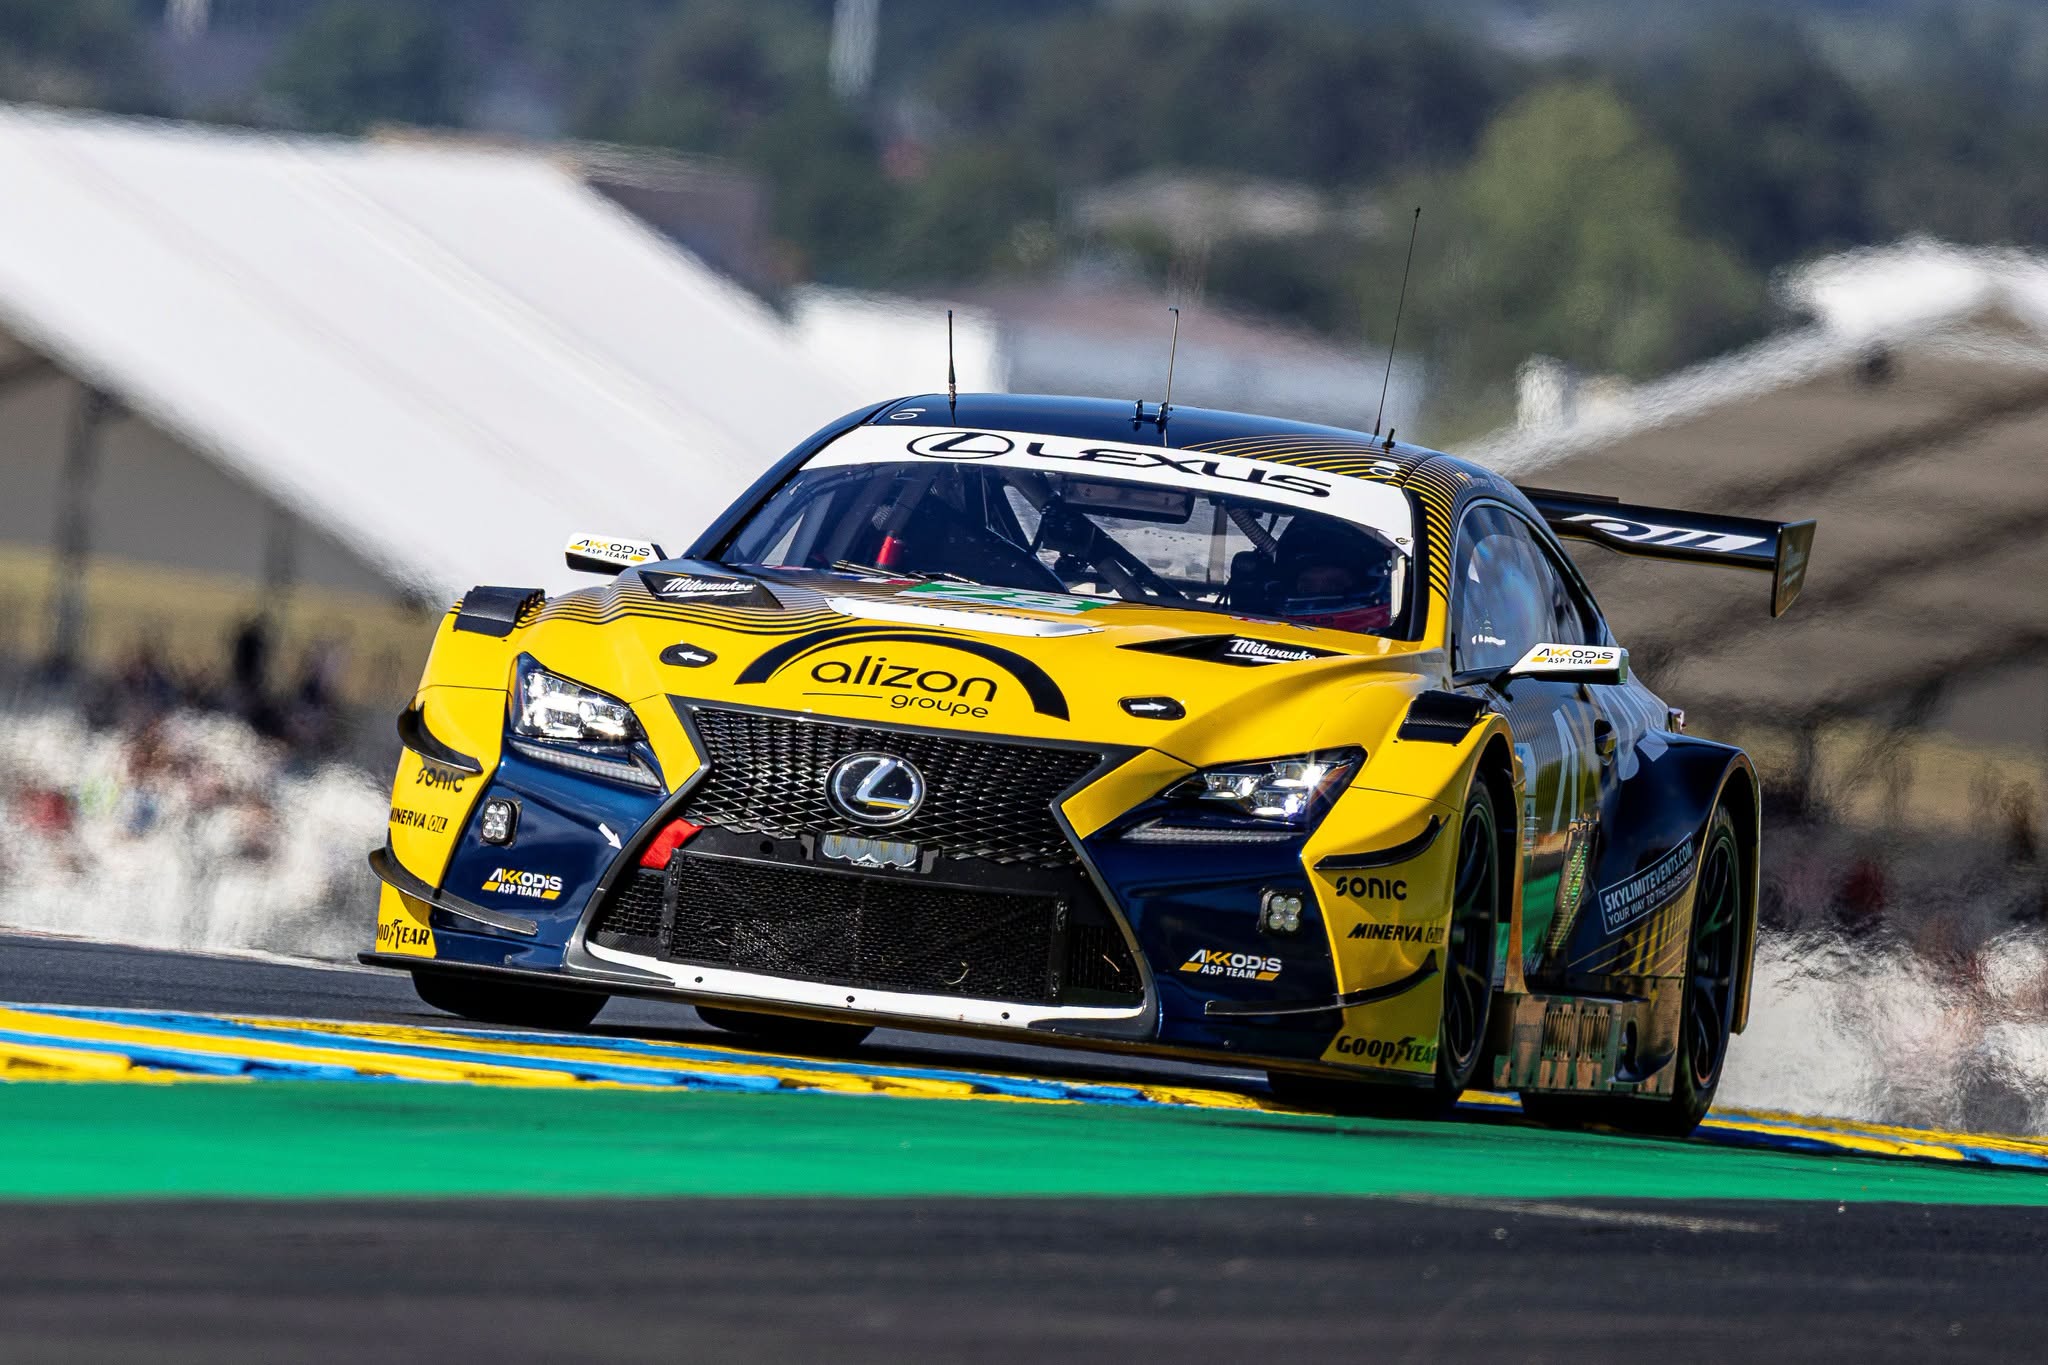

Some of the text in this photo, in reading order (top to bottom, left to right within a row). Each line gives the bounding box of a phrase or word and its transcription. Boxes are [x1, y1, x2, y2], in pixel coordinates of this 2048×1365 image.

[1028, 442, 1331, 497] LEXUS
[584, 548, 628, 561] ASP TEAM
[661, 577, 754, 592] Milwaukee
[1228, 639, 1316, 660] Milwauke
[811, 656, 997, 702] alizon
[890, 694, 988, 718] groupe
[416, 767, 465, 793] SONIC
[498, 882, 541, 898] ASP TEAM
[1335, 876, 1407, 901] SONIC
[1608, 907, 1630, 926] YOUR
[1630, 899, 1645, 915] WAY
[1646, 893, 1655, 905] TO
[1347, 923, 1423, 942] MINERVA
[1201, 964, 1256, 979] ASP TEAM
